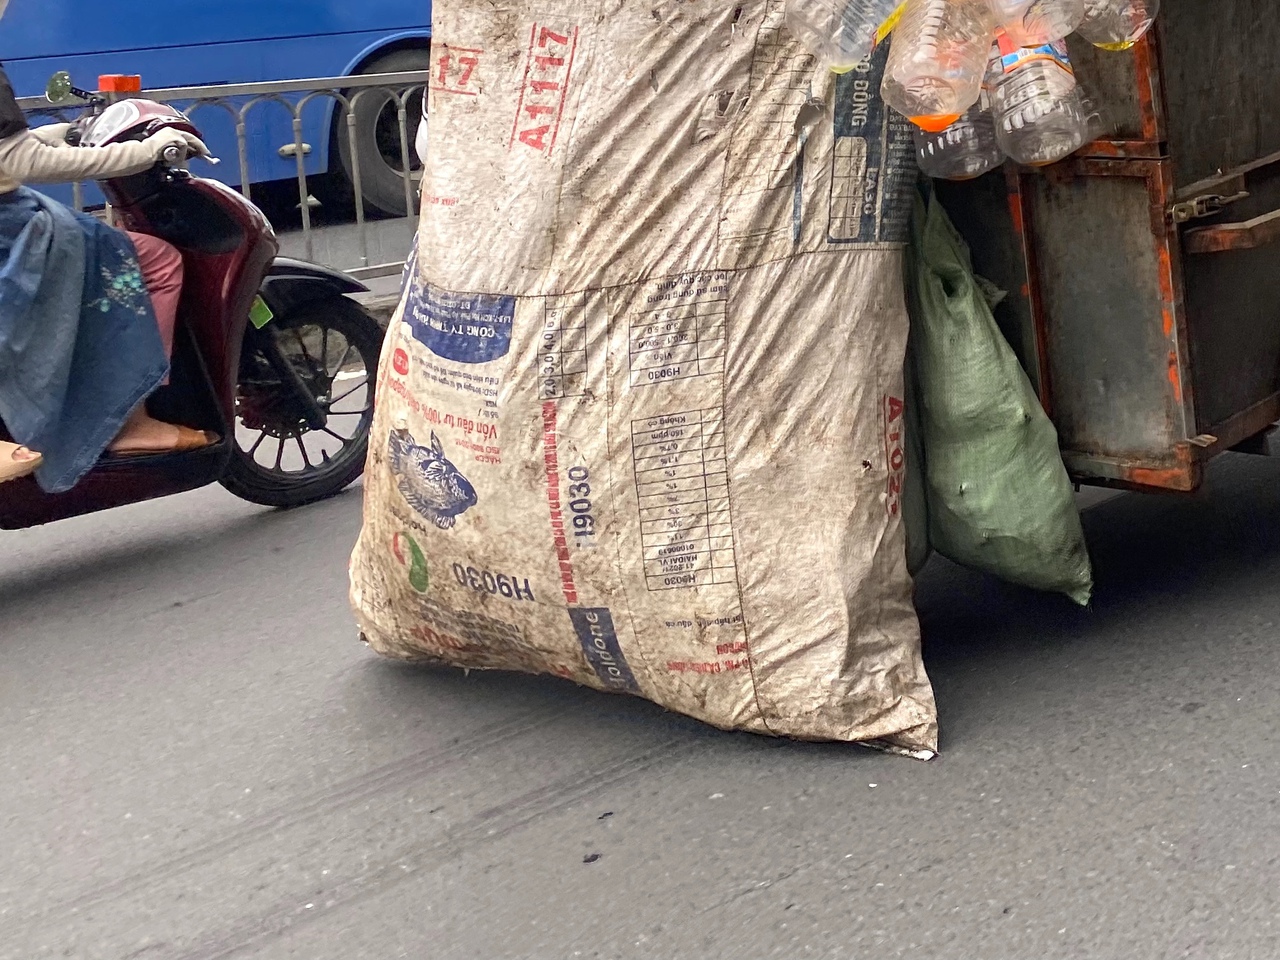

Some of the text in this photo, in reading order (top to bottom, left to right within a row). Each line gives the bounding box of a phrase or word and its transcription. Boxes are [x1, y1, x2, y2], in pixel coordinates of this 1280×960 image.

[518, 26, 568, 151] A1117
[451, 324, 464, 335] TY
[647, 367, 681, 381] H9030
[457, 417, 474, 437] đầu
[476, 422, 498, 442] Vốn
[453, 562, 535, 602] H9030
